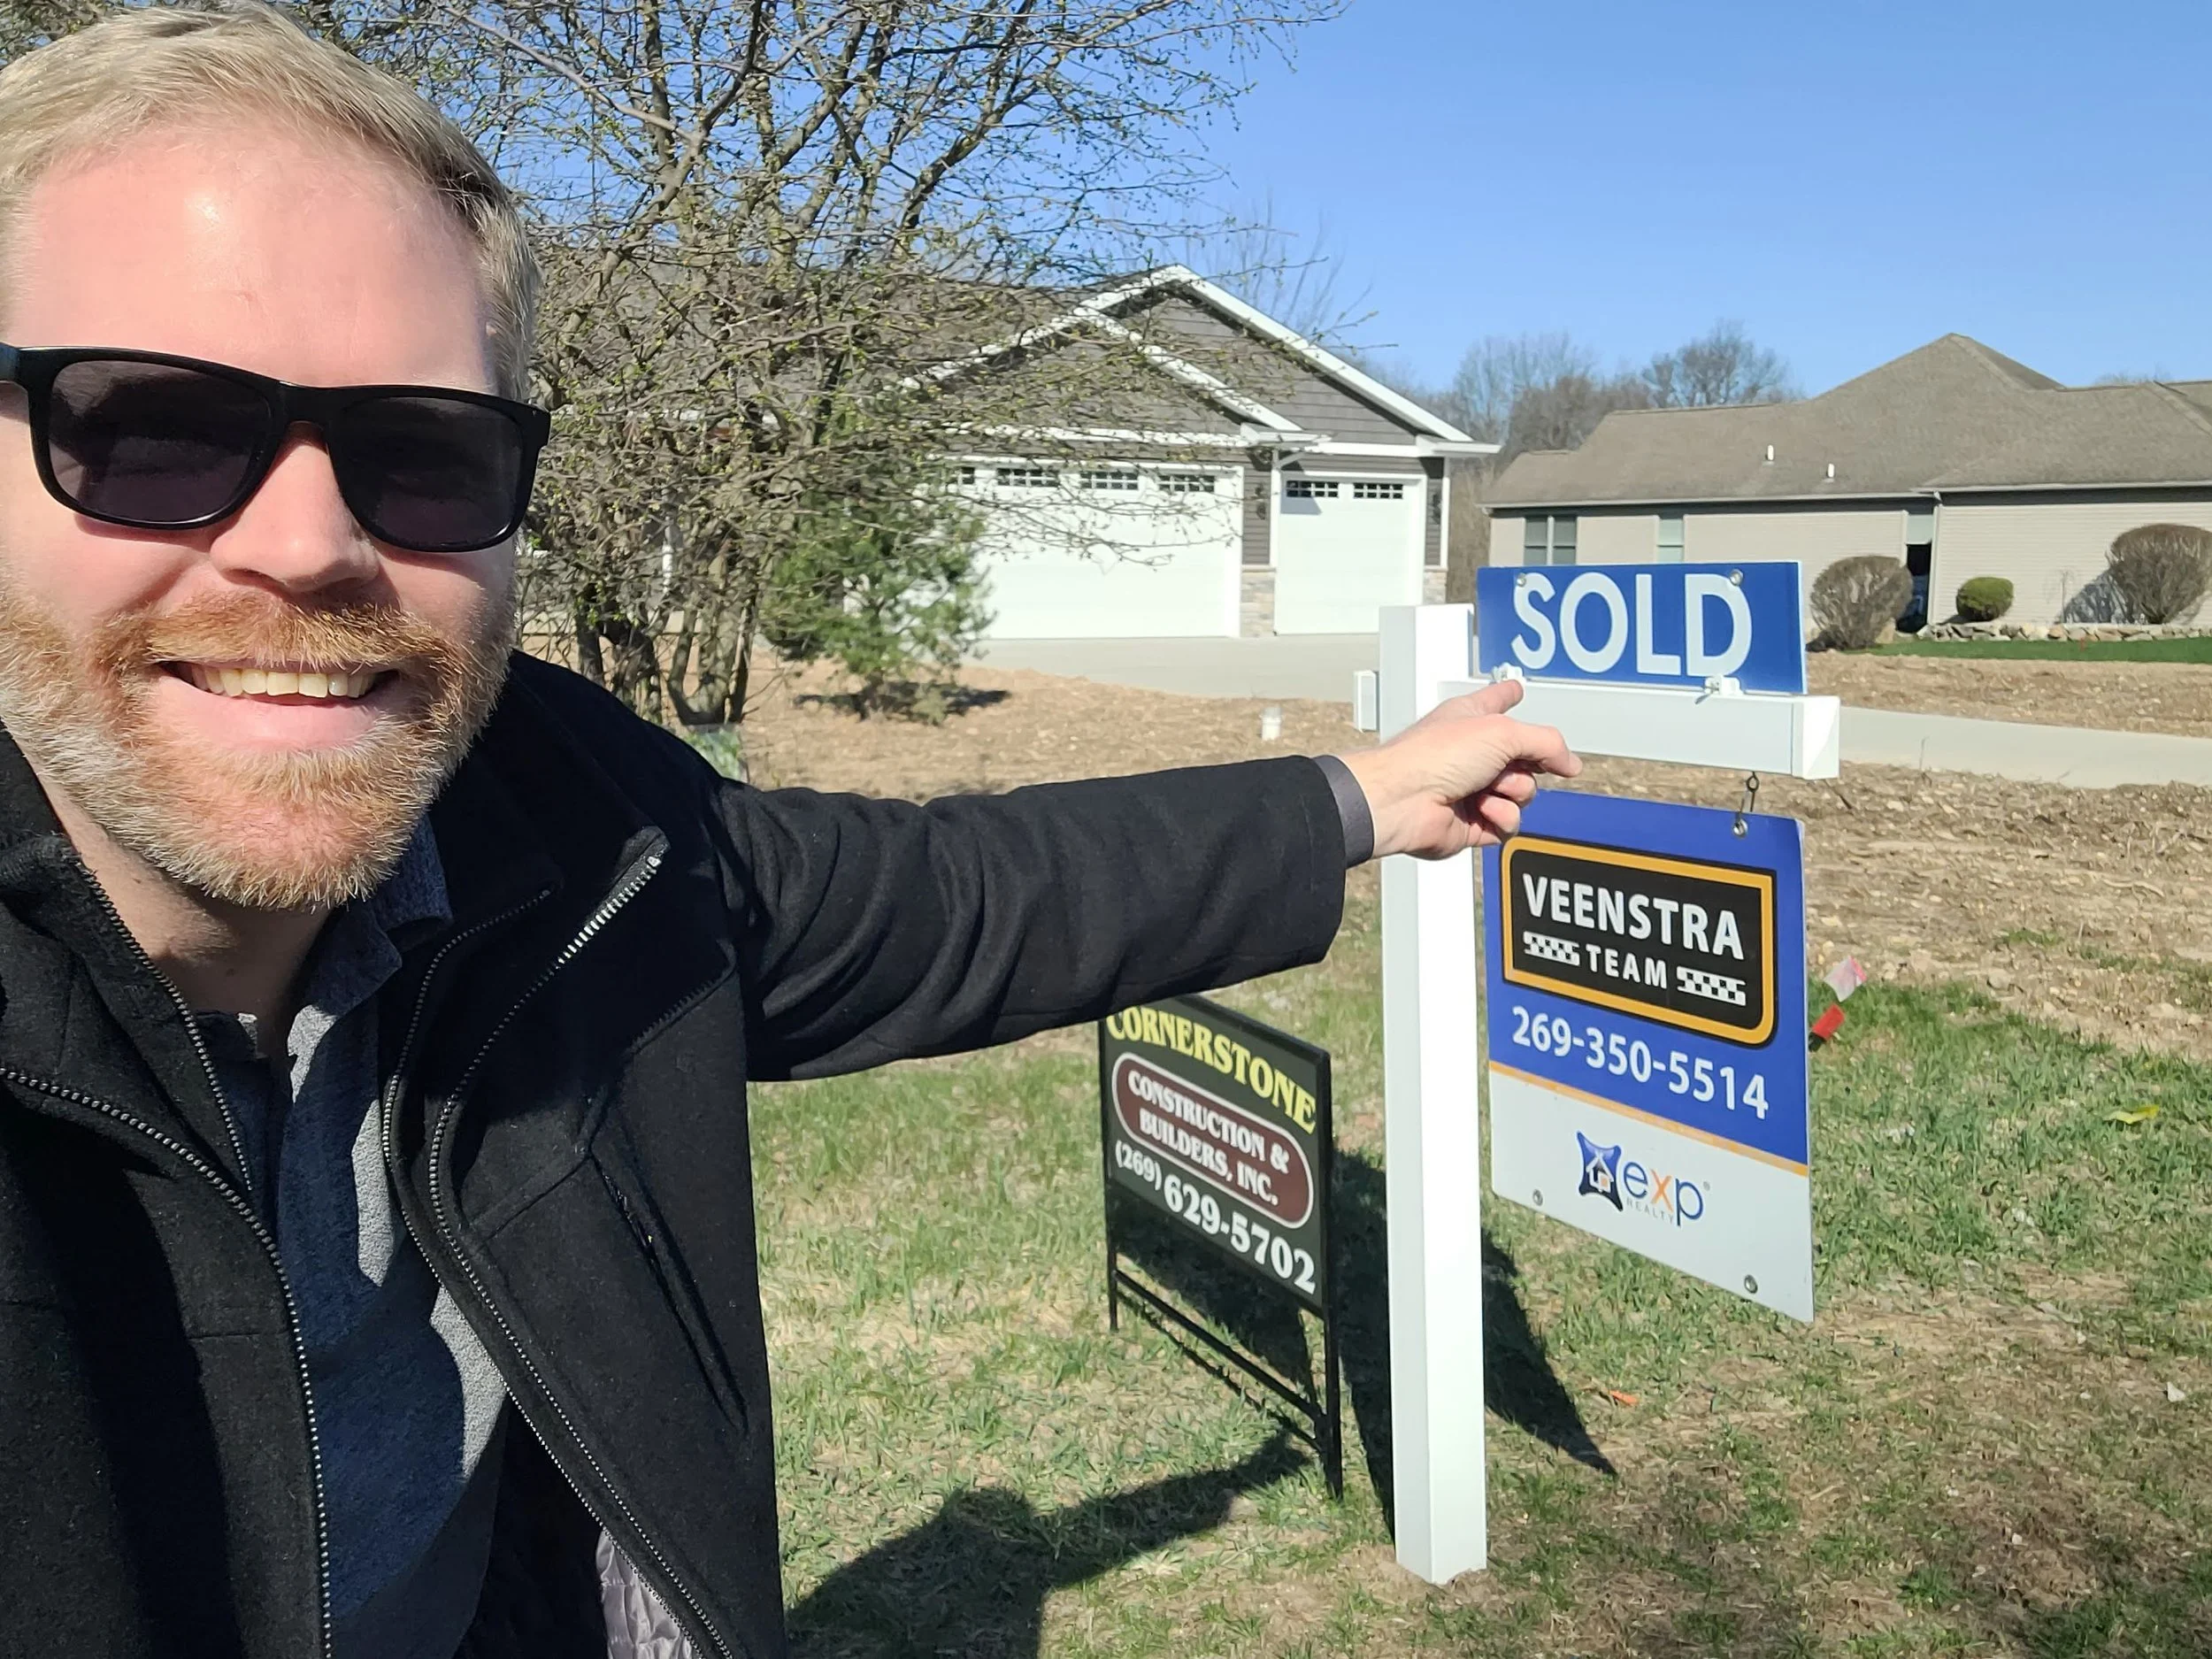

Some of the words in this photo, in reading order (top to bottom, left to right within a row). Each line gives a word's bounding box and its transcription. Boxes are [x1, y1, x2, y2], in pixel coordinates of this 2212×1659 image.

[1510, 572, 1752, 677] SOLD
[1523, 872, 1744, 960] VEENSTRA
[1586, 944, 1668, 989] TEAM
[1106, 1006, 1317, 1135] CORNERSTONE
[1512, 1006, 1770, 1119] 269-350-5514
[1128, 1071, 1266, 1162] CONSTRUCTION
[1271, 1136, 1290, 1174] &
[1139, 1108, 1233, 1182] BUILDERS,
[1237, 1161, 1279, 1206] INC.
[1115, 1140, 1162, 1192] (269)
[1164, 1174, 1317, 1295] 629-5702
[1626, 1198, 1674, 1225] REALTY
